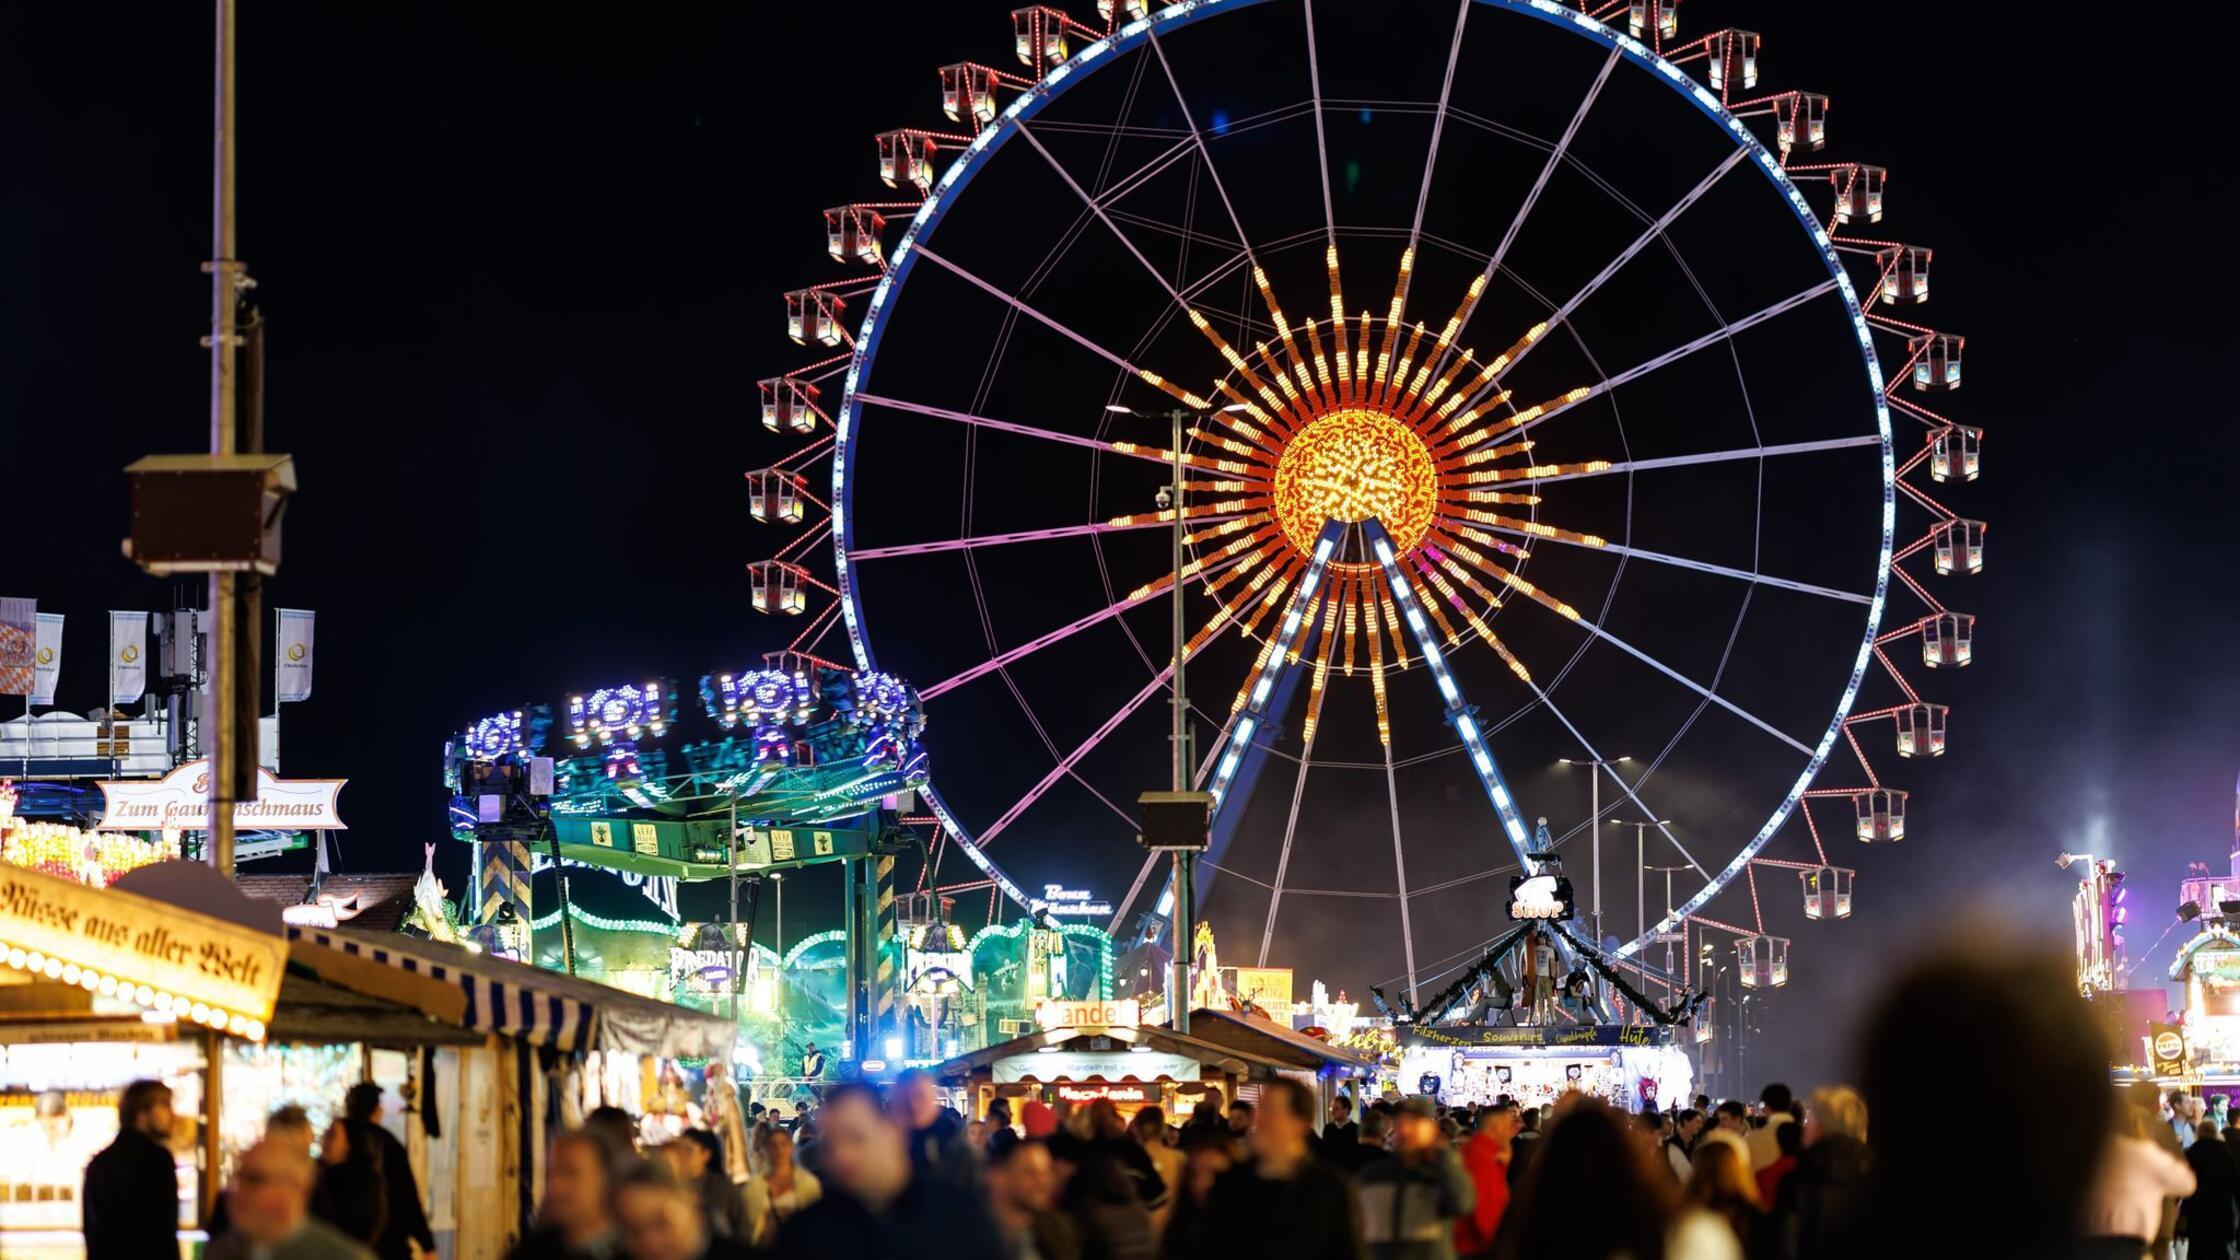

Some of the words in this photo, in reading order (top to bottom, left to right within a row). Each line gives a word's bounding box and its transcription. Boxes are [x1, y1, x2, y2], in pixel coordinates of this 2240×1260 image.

[115, 801, 158, 817] Zum
[164, 799, 324, 818] Gaunschmaus
[1512, 901, 1564, 918] SHOP
[84, 915, 128, 946] aus
[135, 926, 193, 965] aller
[199, 940, 261, 986] Welt
